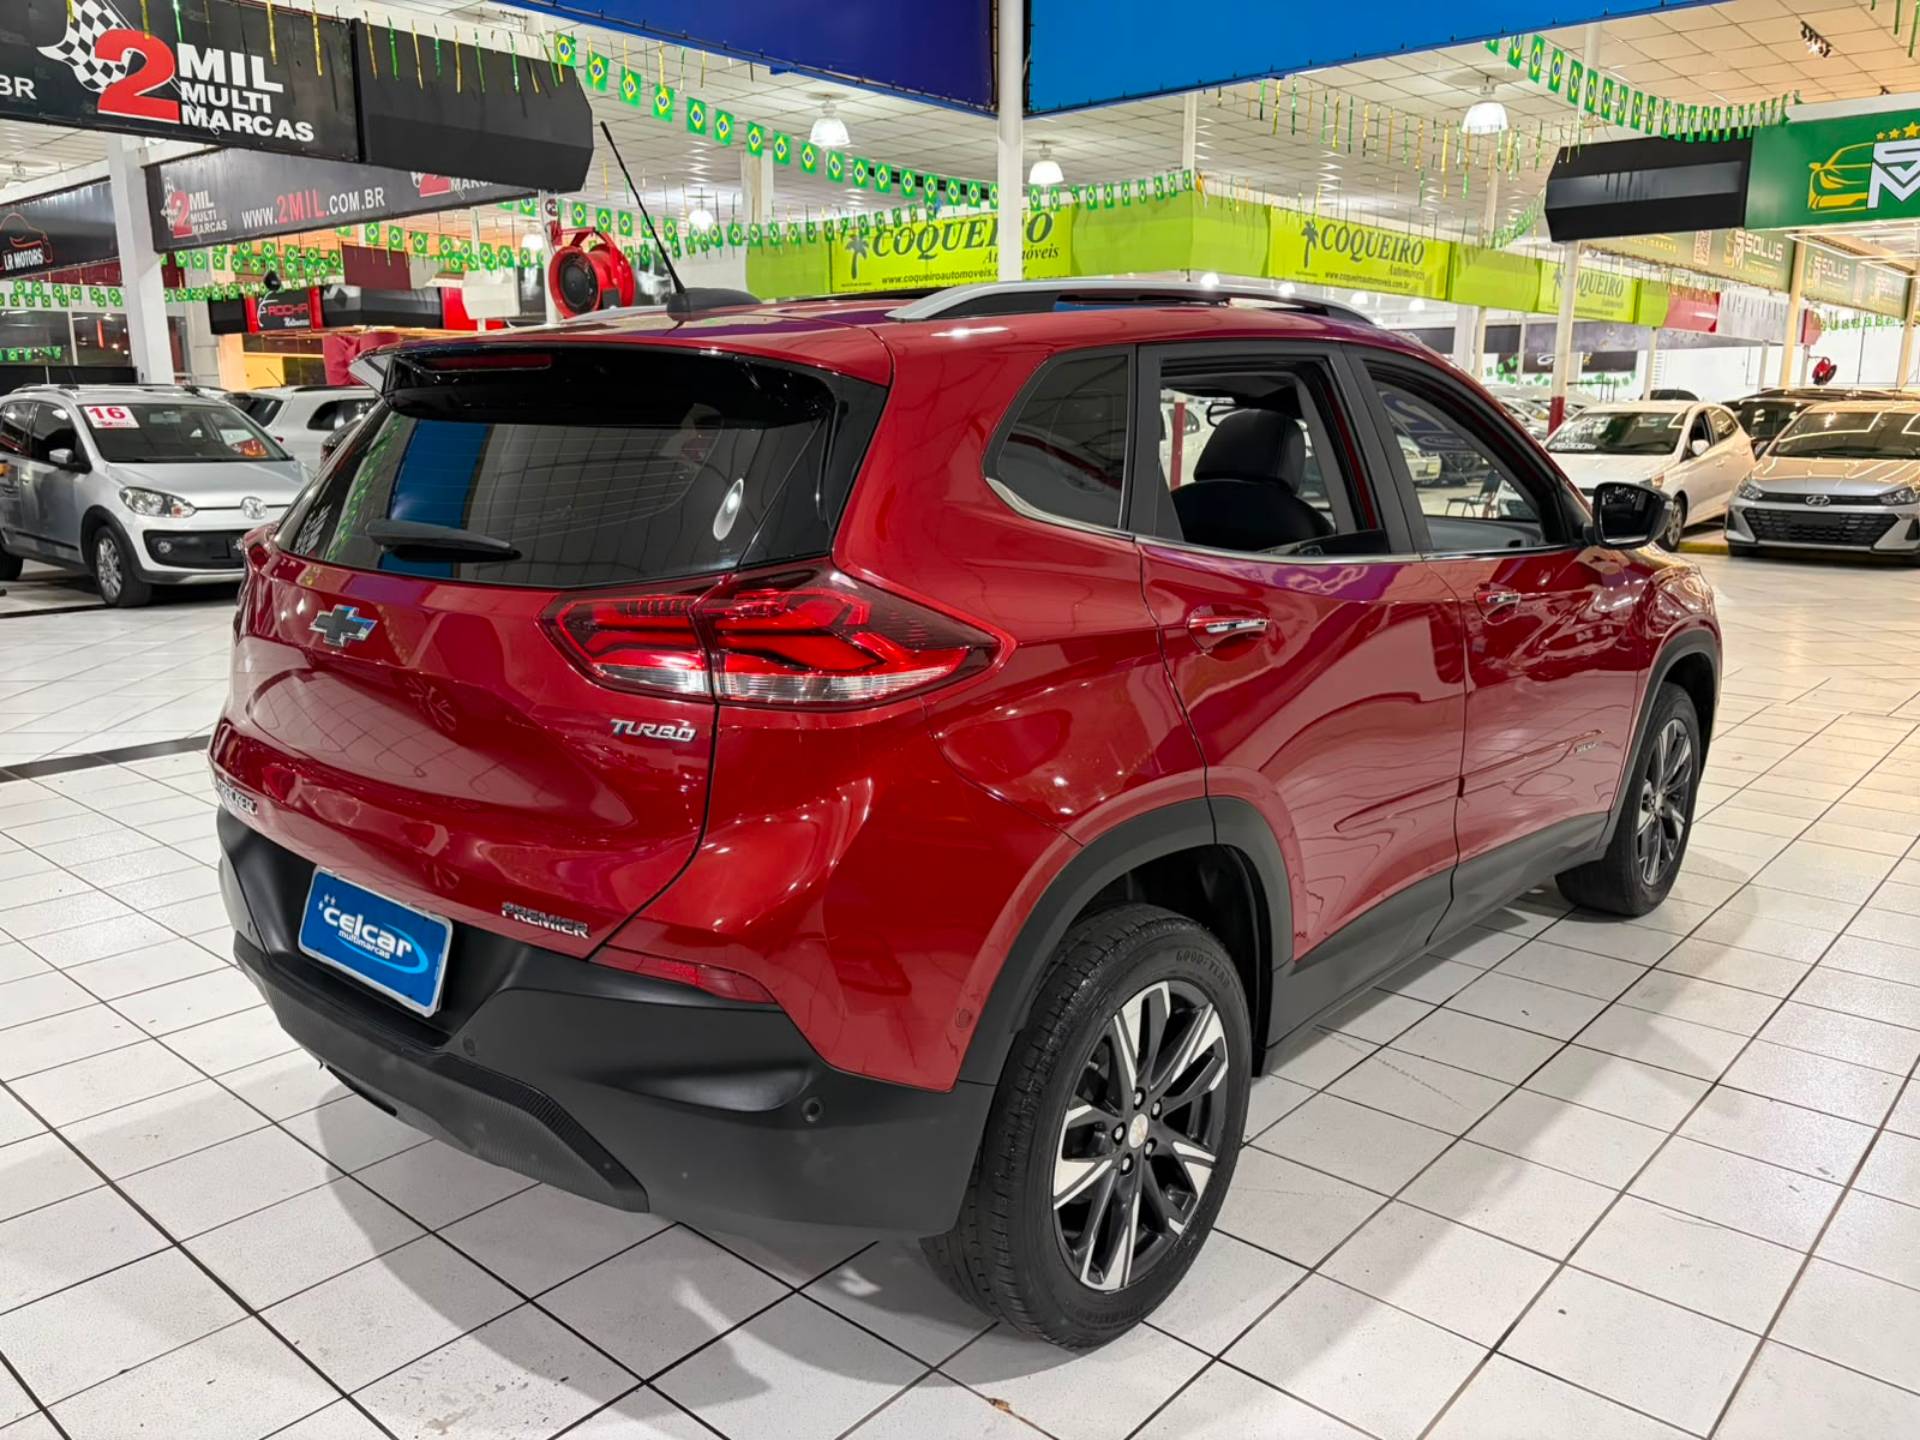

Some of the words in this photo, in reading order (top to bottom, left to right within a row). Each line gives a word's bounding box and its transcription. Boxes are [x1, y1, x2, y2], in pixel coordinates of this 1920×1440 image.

[94, 28, 180, 124] 2
[177, 42, 284, 93] MIL
[180, 80, 272, 114] MULTI
[181, 104, 315, 142] MARCAS
[188, 190, 215, 210] MIL
[190, 209, 217, 222] MULTI
[241, 187, 386, 229] WWW.2MIL.COM.BR
[192, 220, 228, 236] MARCAS
[872, 212, 1054, 260] COQUEIO
[1321, 223, 1426, 265] COQUEIRO
[14, 248, 43, 269] MOTORS
[88, 407, 126, 419] 16
[610, 718, 696, 742] TURBO
[323, 906, 412, 958] celcar
[502, 901, 590, 939] PREMIER
[338, 929, 391, 960] multimarcas
